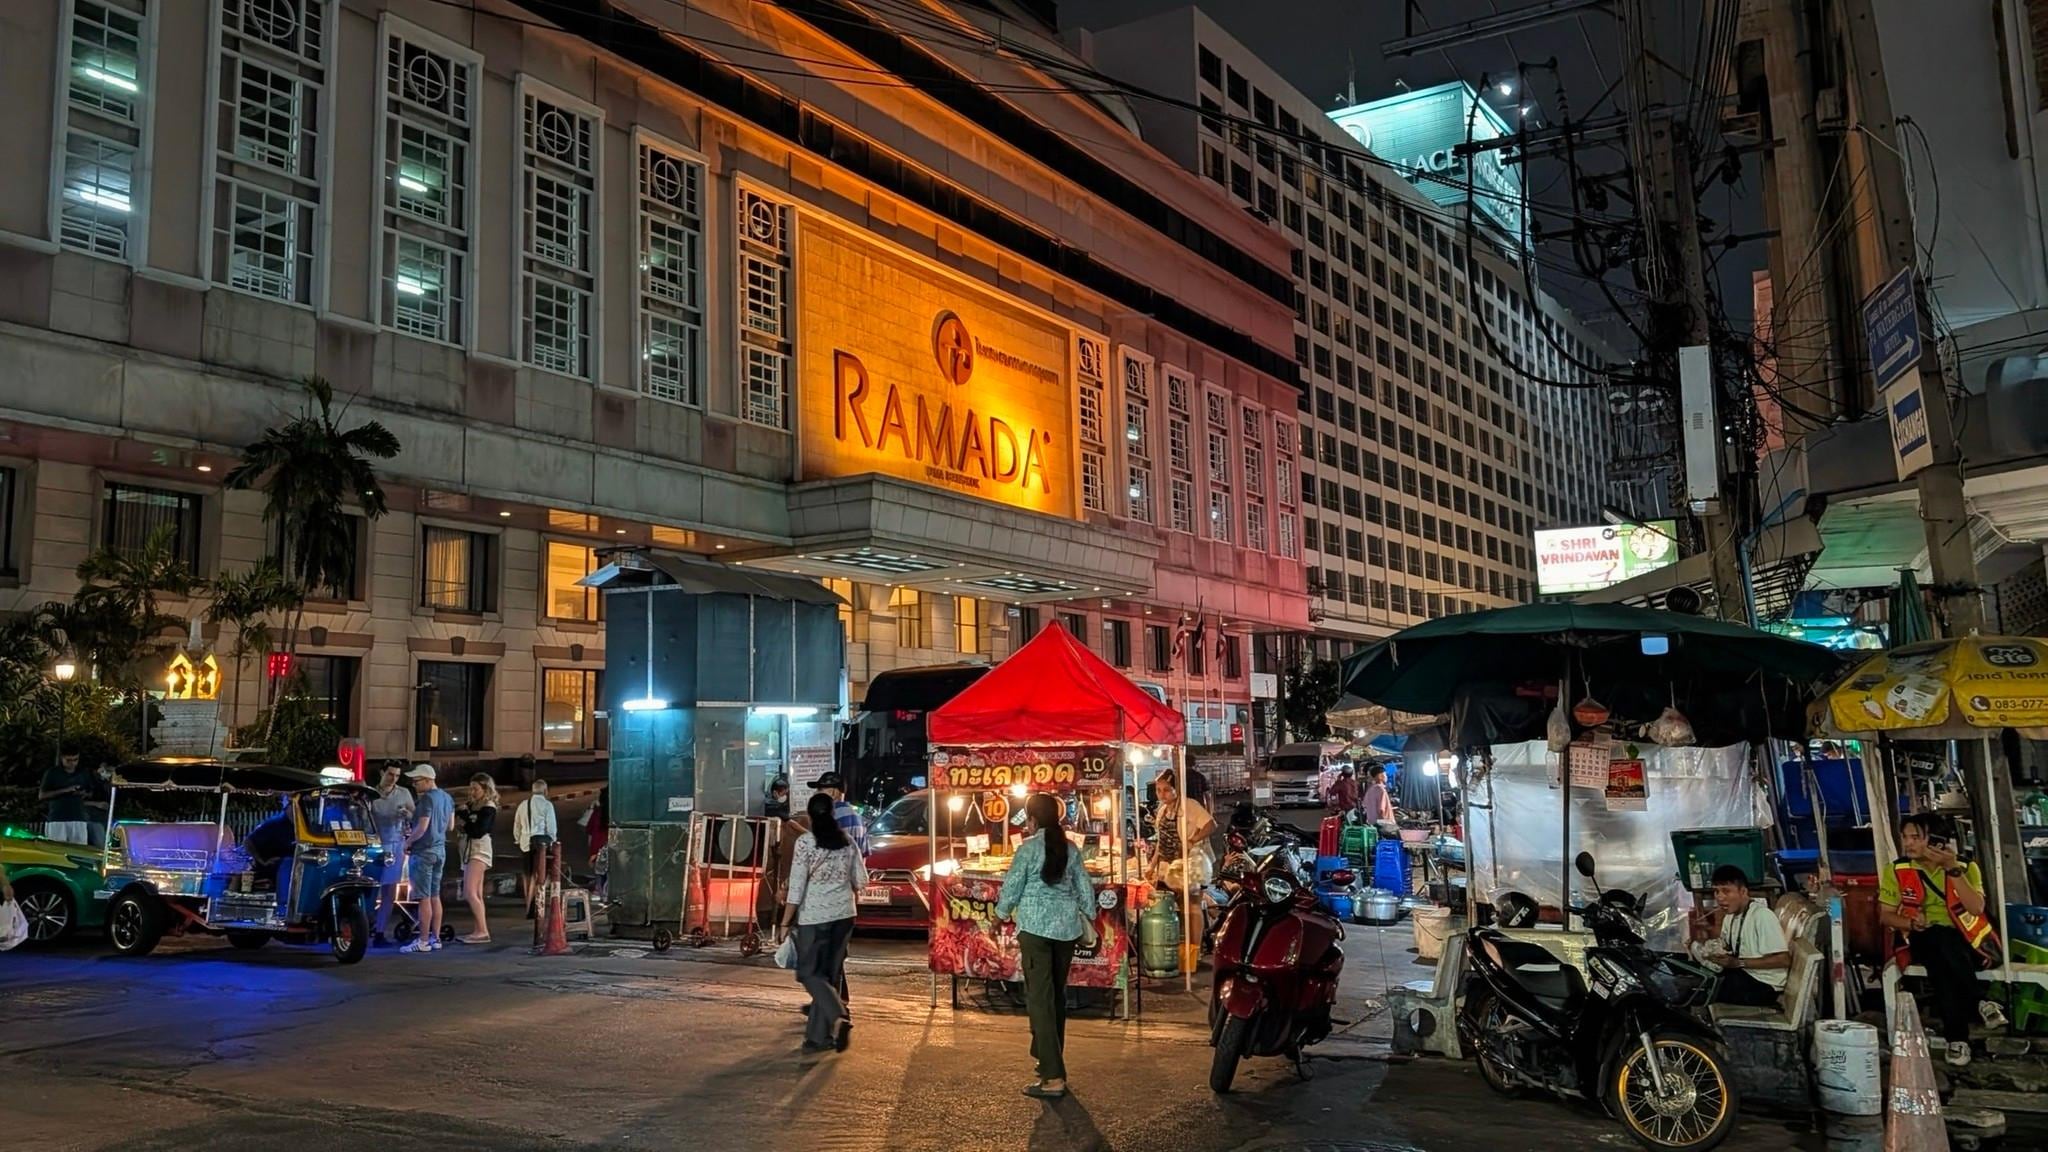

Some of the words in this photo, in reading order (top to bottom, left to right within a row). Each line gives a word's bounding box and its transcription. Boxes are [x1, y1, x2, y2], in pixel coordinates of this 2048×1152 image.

[833, 348, 1051, 494] RAMADA
[1560, 537, 1597, 551] SHRI
[1541, 549, 1620, 565] VRINDAVAN
[1989, 653, 2034, 665] ete
[1082, 757, 1105, 772] 10
[949, 762, 1075, 787] ทะเลทอด
[984, 799, 1005, 817] 10
